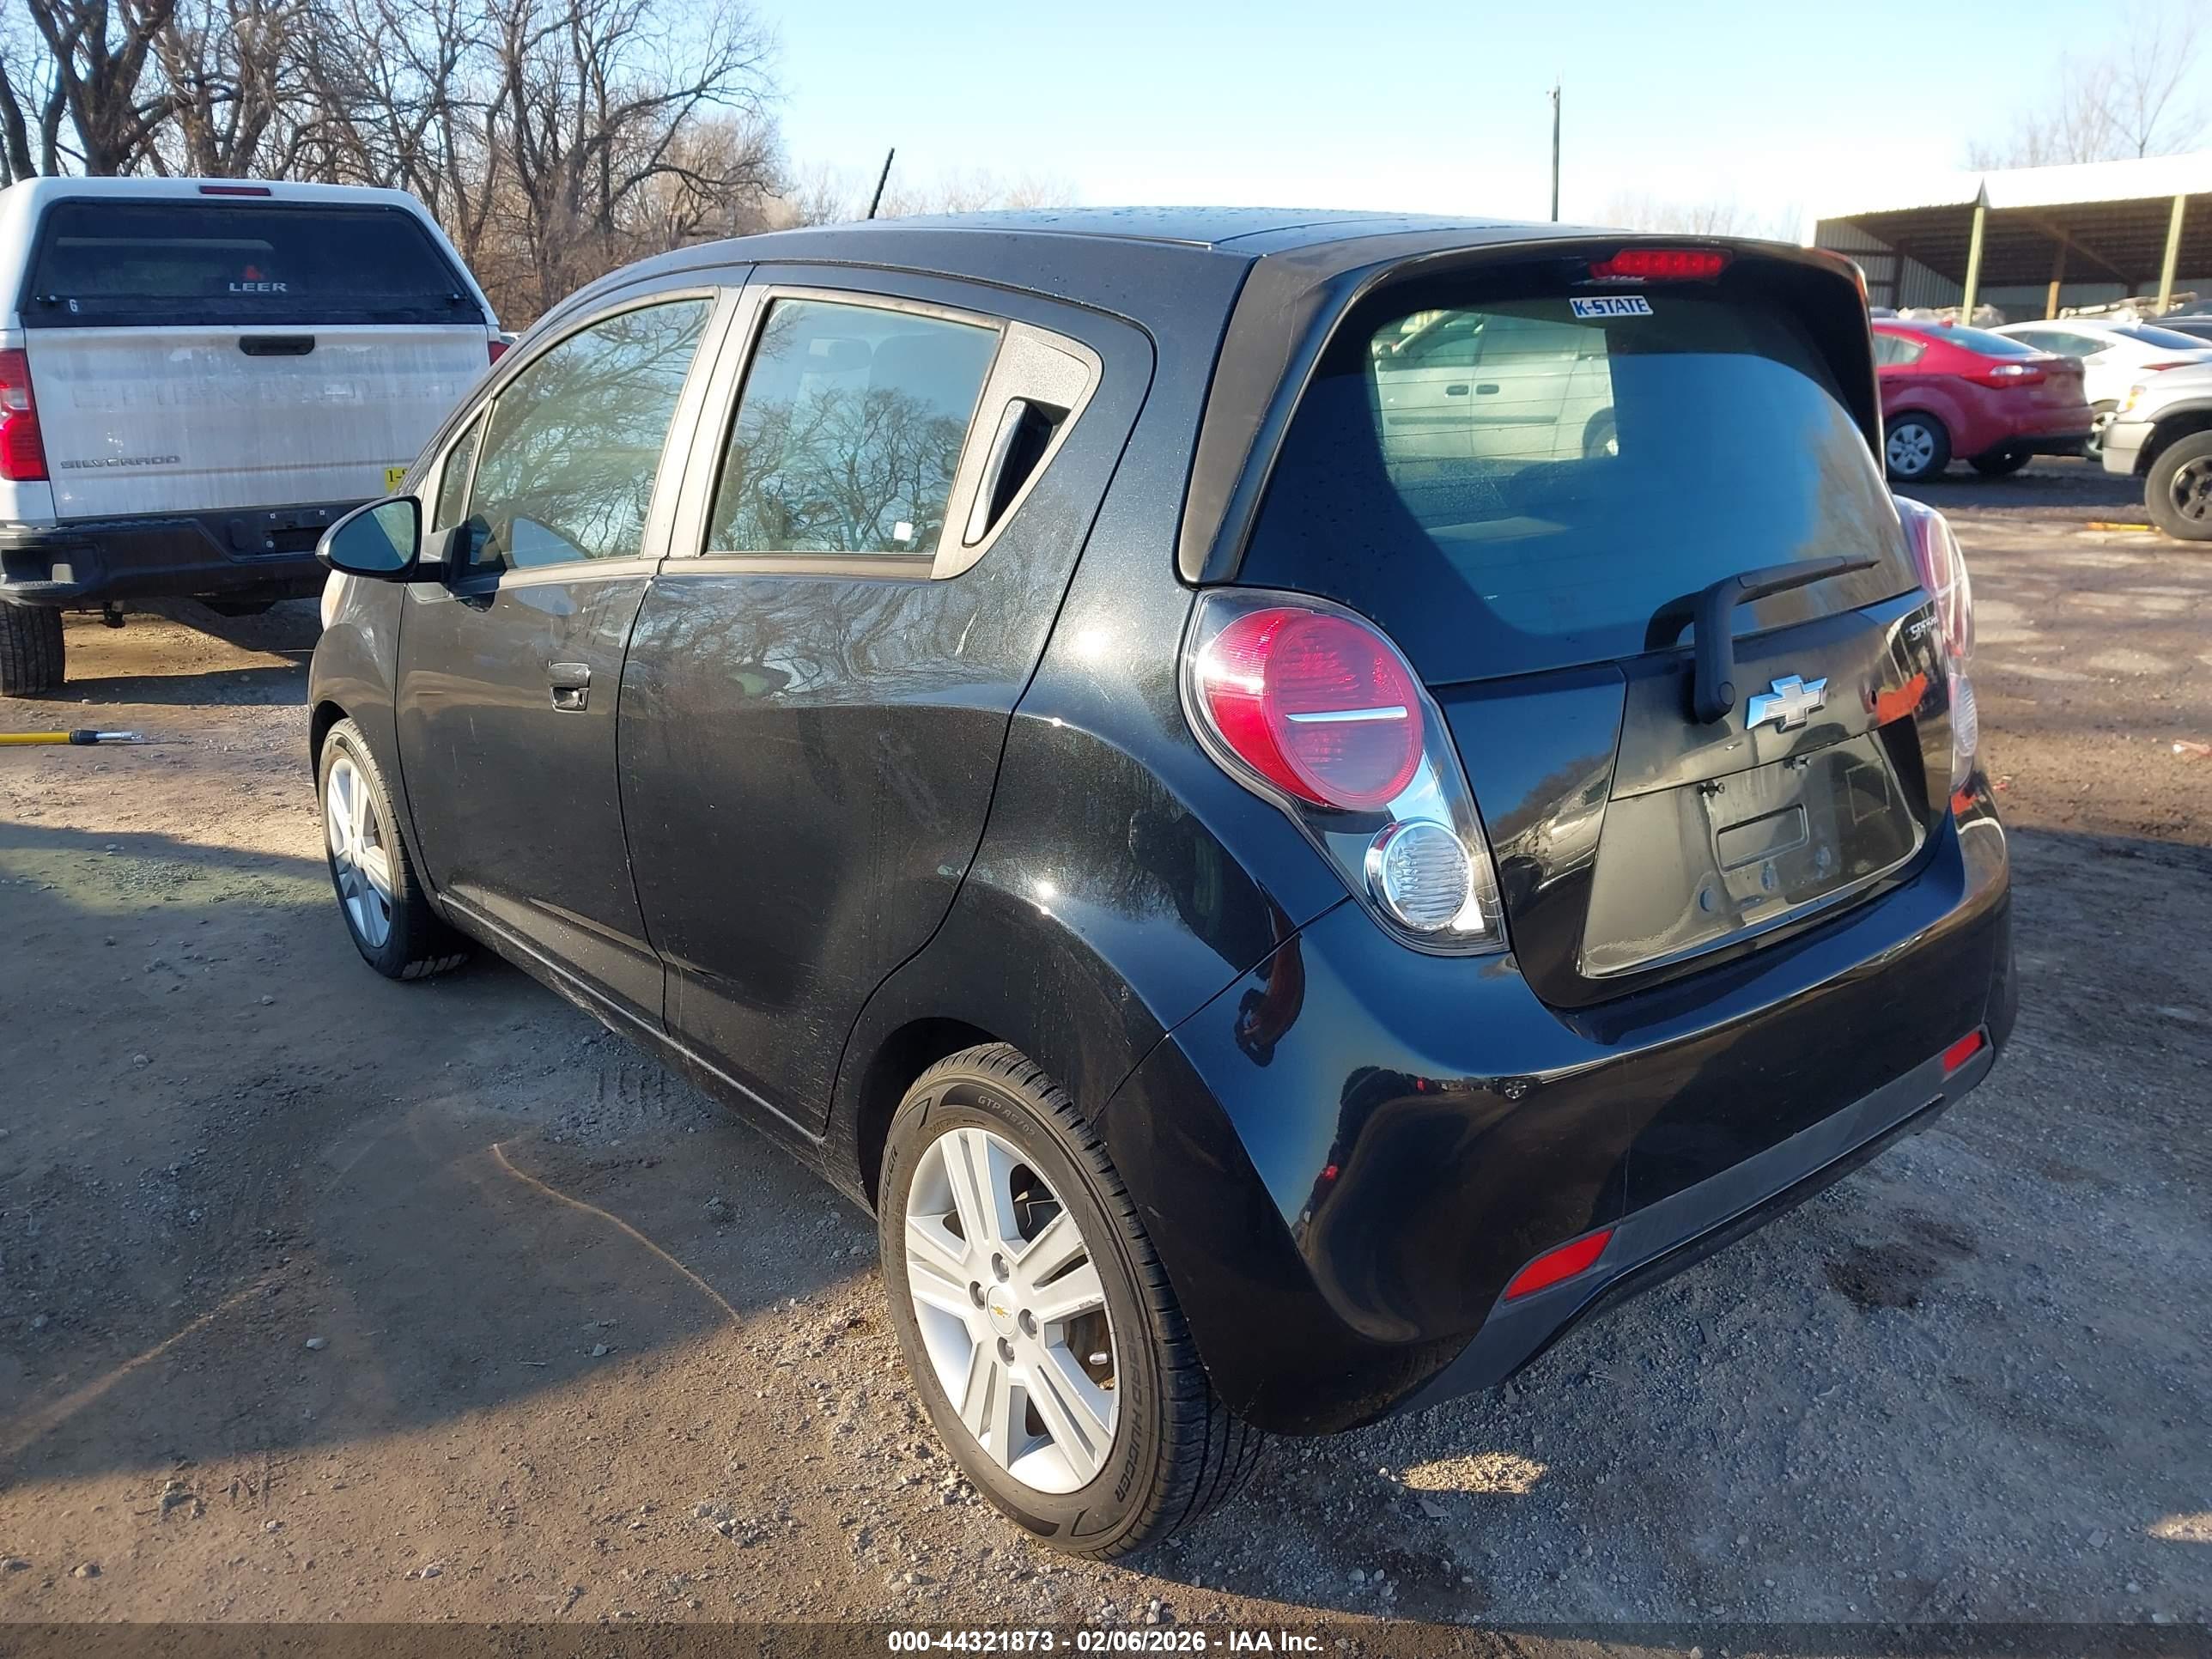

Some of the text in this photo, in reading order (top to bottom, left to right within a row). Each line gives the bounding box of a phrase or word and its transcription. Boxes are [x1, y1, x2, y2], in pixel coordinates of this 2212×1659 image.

[228, 282, 288, 292] LEER
[1572, 298, 1649, 316] K-STATE
[60, 455, 181, 469] SILVERADO
[977, 1095, 1002, 1110] GTP
[1115, 1408, 1143, 1503] HUGGER
